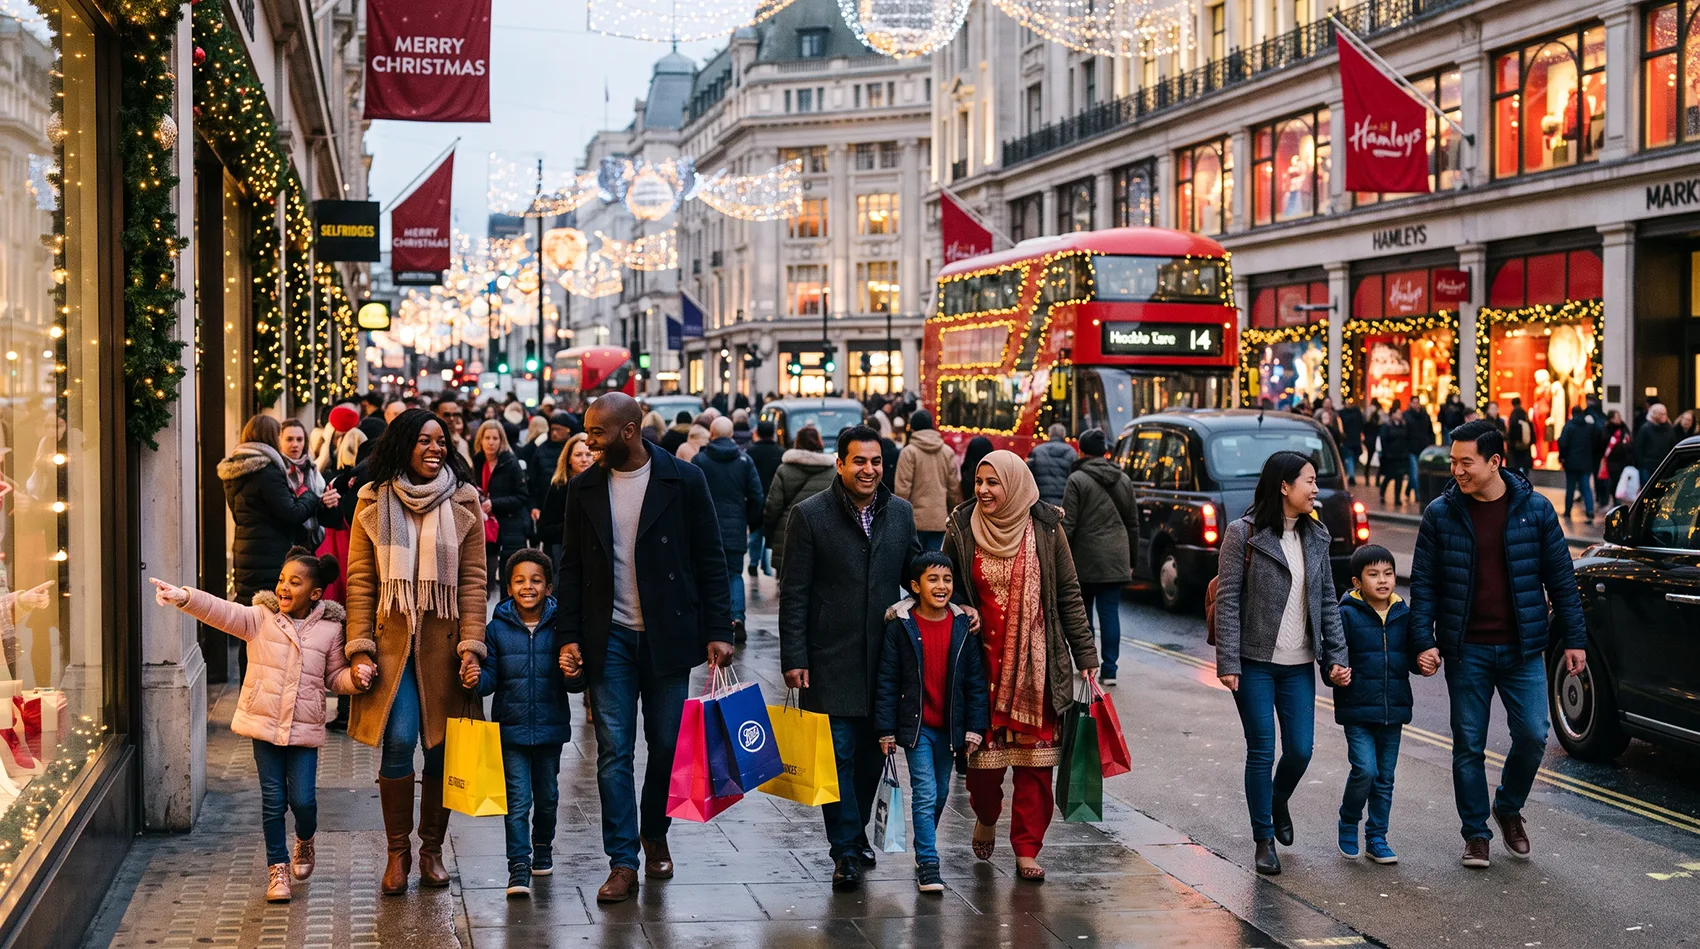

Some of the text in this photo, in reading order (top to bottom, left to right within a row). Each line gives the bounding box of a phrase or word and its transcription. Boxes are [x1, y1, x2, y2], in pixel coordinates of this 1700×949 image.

[394, 36, 465, 55] MERRY
[371, 55, 486, 76] CHRISTMAS
[1348, 114, 1422, 157] Hamleys
[1646, 178, 1700, 210] MARK
[320, 224, 375, 237] SELFRIDGES
[403, 227, 440, 238] MERRY
[1372, 224, 1427, 251] HAMLEYS
[392, 237, 449, 249] CHRISTMAS
[1190, 329, 1212, 350] 14
